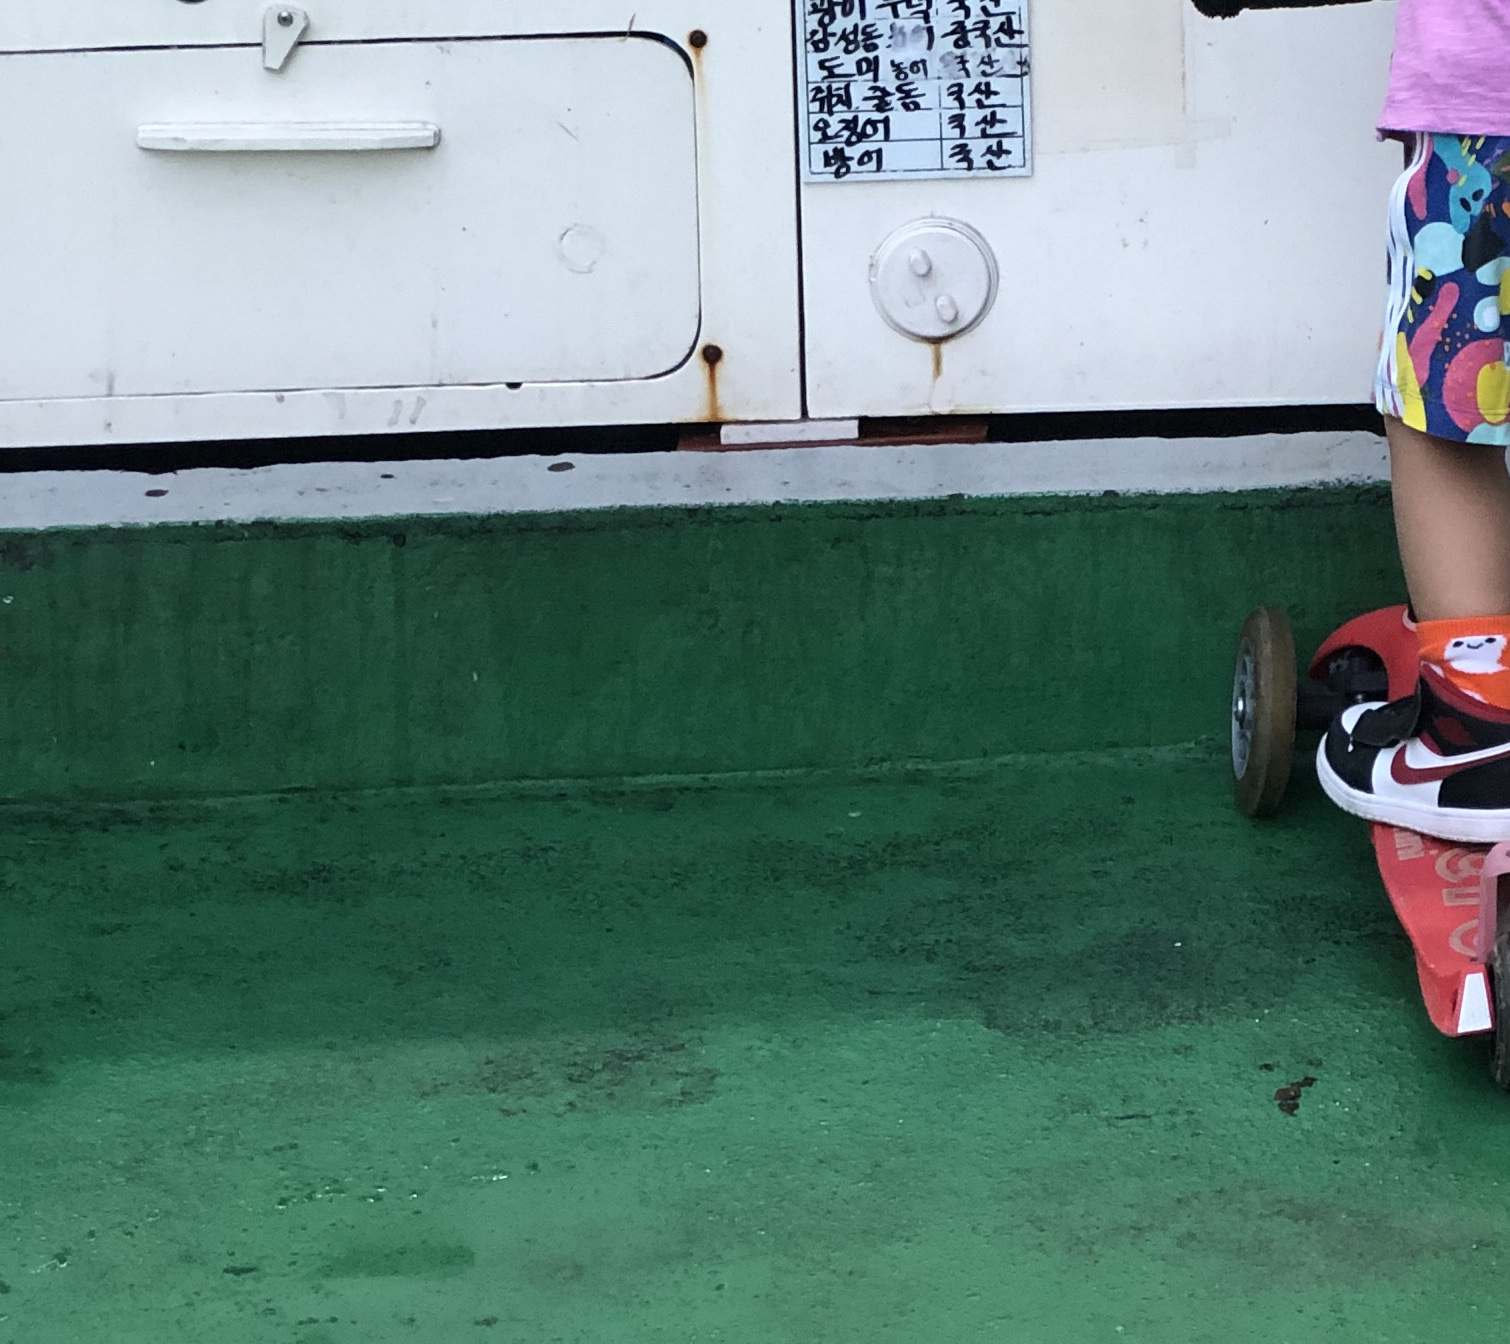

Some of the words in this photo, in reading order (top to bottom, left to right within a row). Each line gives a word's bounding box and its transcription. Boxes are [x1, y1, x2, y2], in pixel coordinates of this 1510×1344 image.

[940, 15, 1029, 49] 중국산
[818, 55, 880, 82] 도미
[890, 58, 928, 80] 농어
[947, 81, 1007, 109] 국산
[812, 115, 890, 147] 오징어
[947, 110, 1018, 138] 국산
[823, 147, 883, 179] 방어
[949, 140, 1012, 171] 국산
